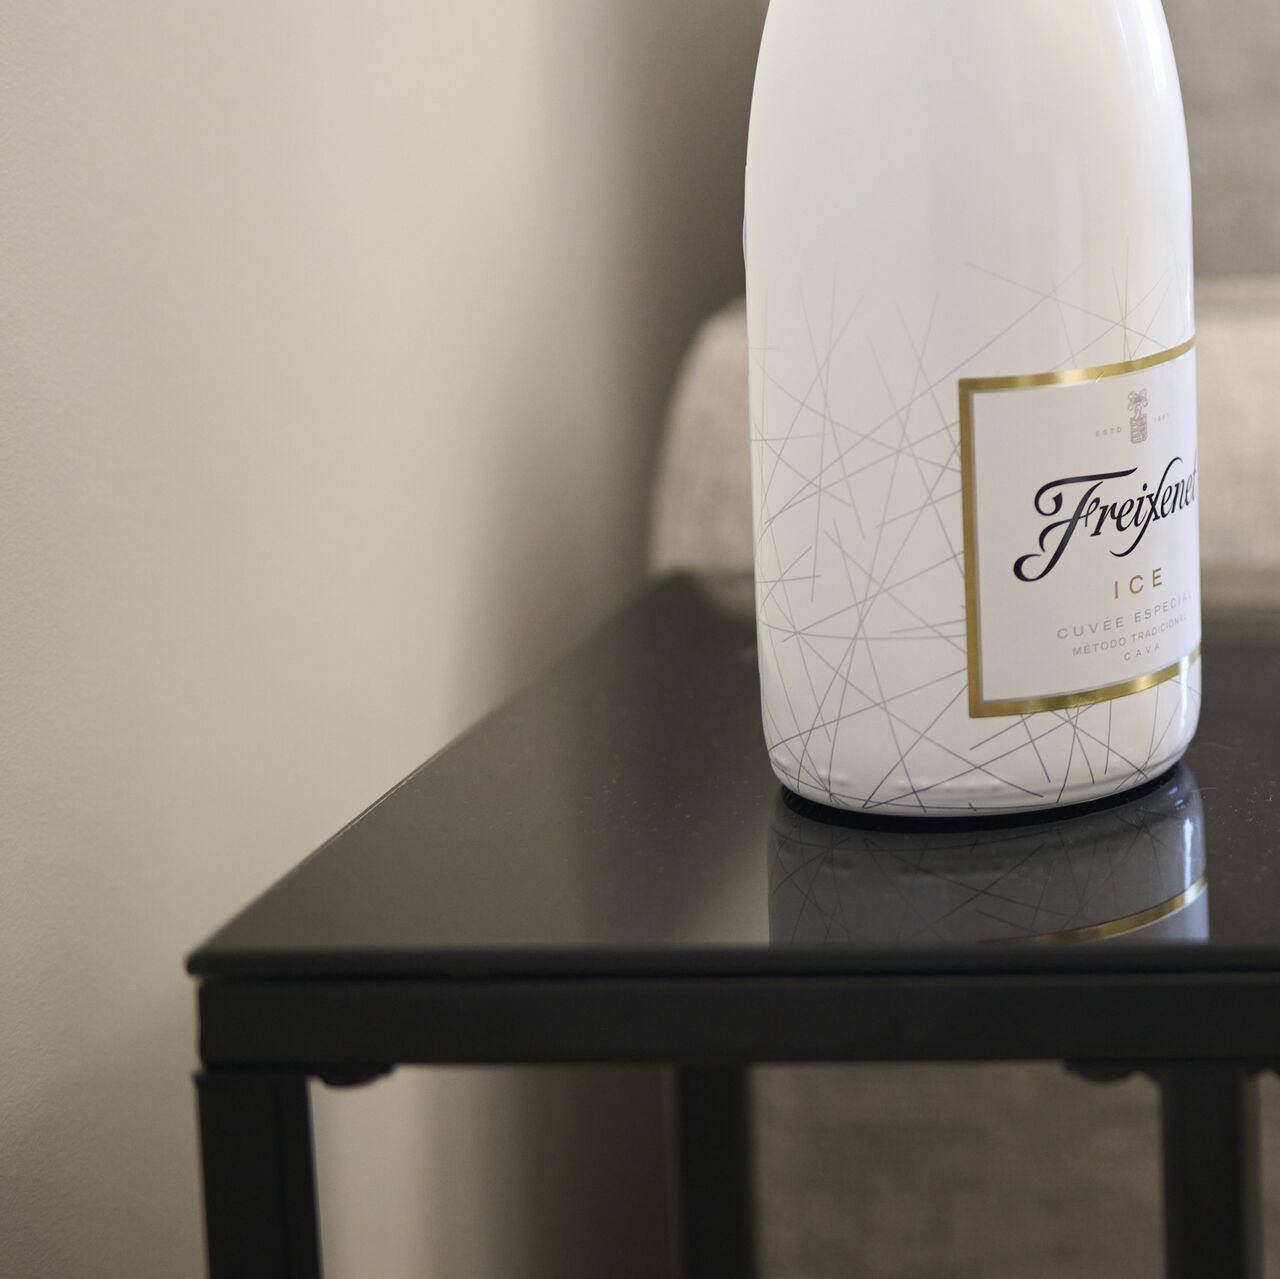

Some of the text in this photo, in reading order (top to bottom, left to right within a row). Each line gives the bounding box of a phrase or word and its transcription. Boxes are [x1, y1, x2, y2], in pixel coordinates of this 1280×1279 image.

[1113, 567, 1163, 600] ICE
[1056, 616, 1125, 640] CUVÉE
[1123, 643, 1161, 661] CAVA
